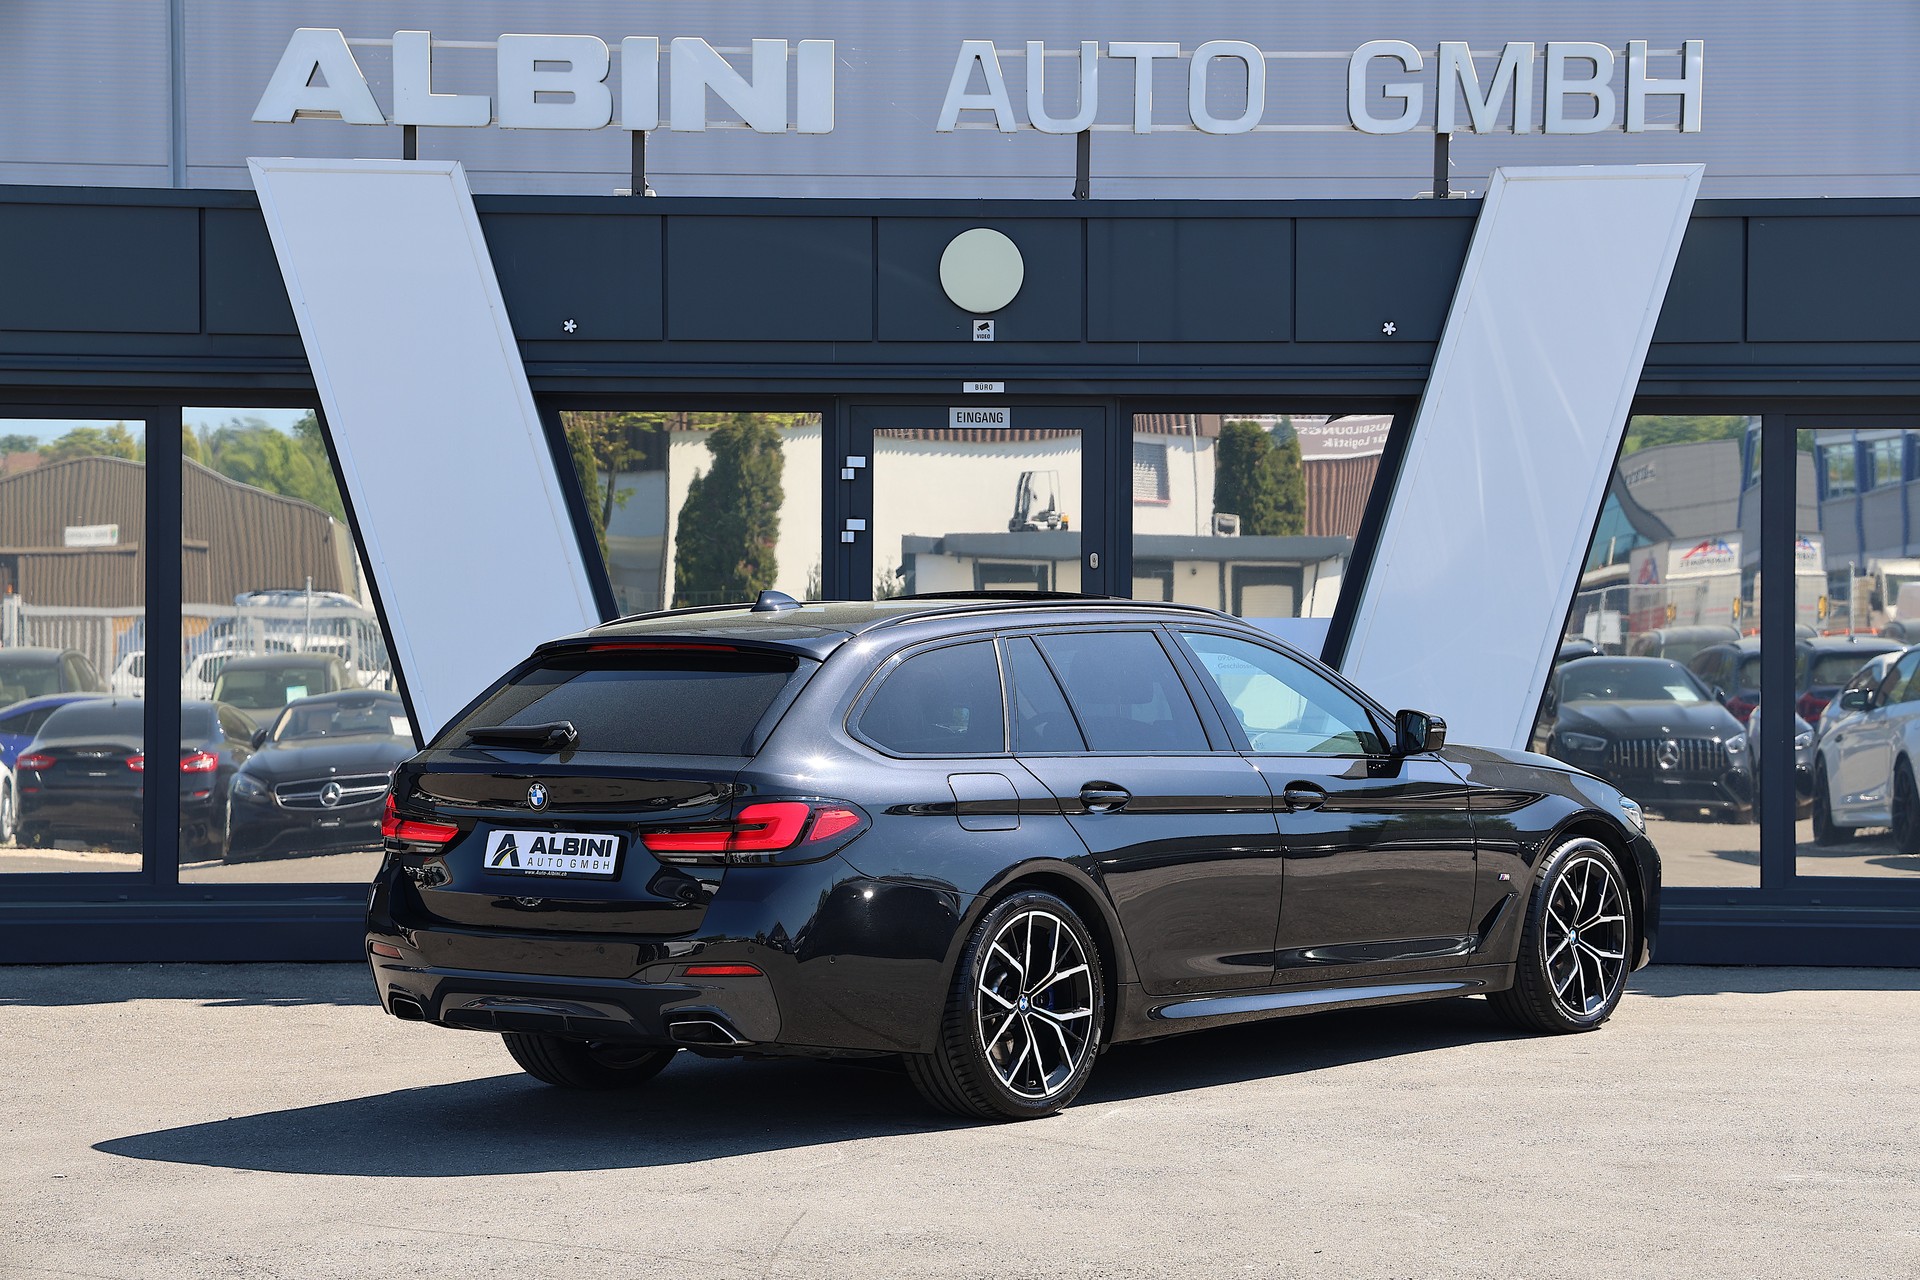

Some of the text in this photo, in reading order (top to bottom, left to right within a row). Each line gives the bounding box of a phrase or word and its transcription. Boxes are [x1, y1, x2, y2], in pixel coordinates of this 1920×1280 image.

[251, 28, 1704, 135] ALBINI AUTO GMBH
[974, 383, 993, 391] BÜRO
[956, 411, 1004, 424] EINGANG
[529, 836, 613, 857] ALBINI
[527, 857, 610, 870] AUTO GMBH
